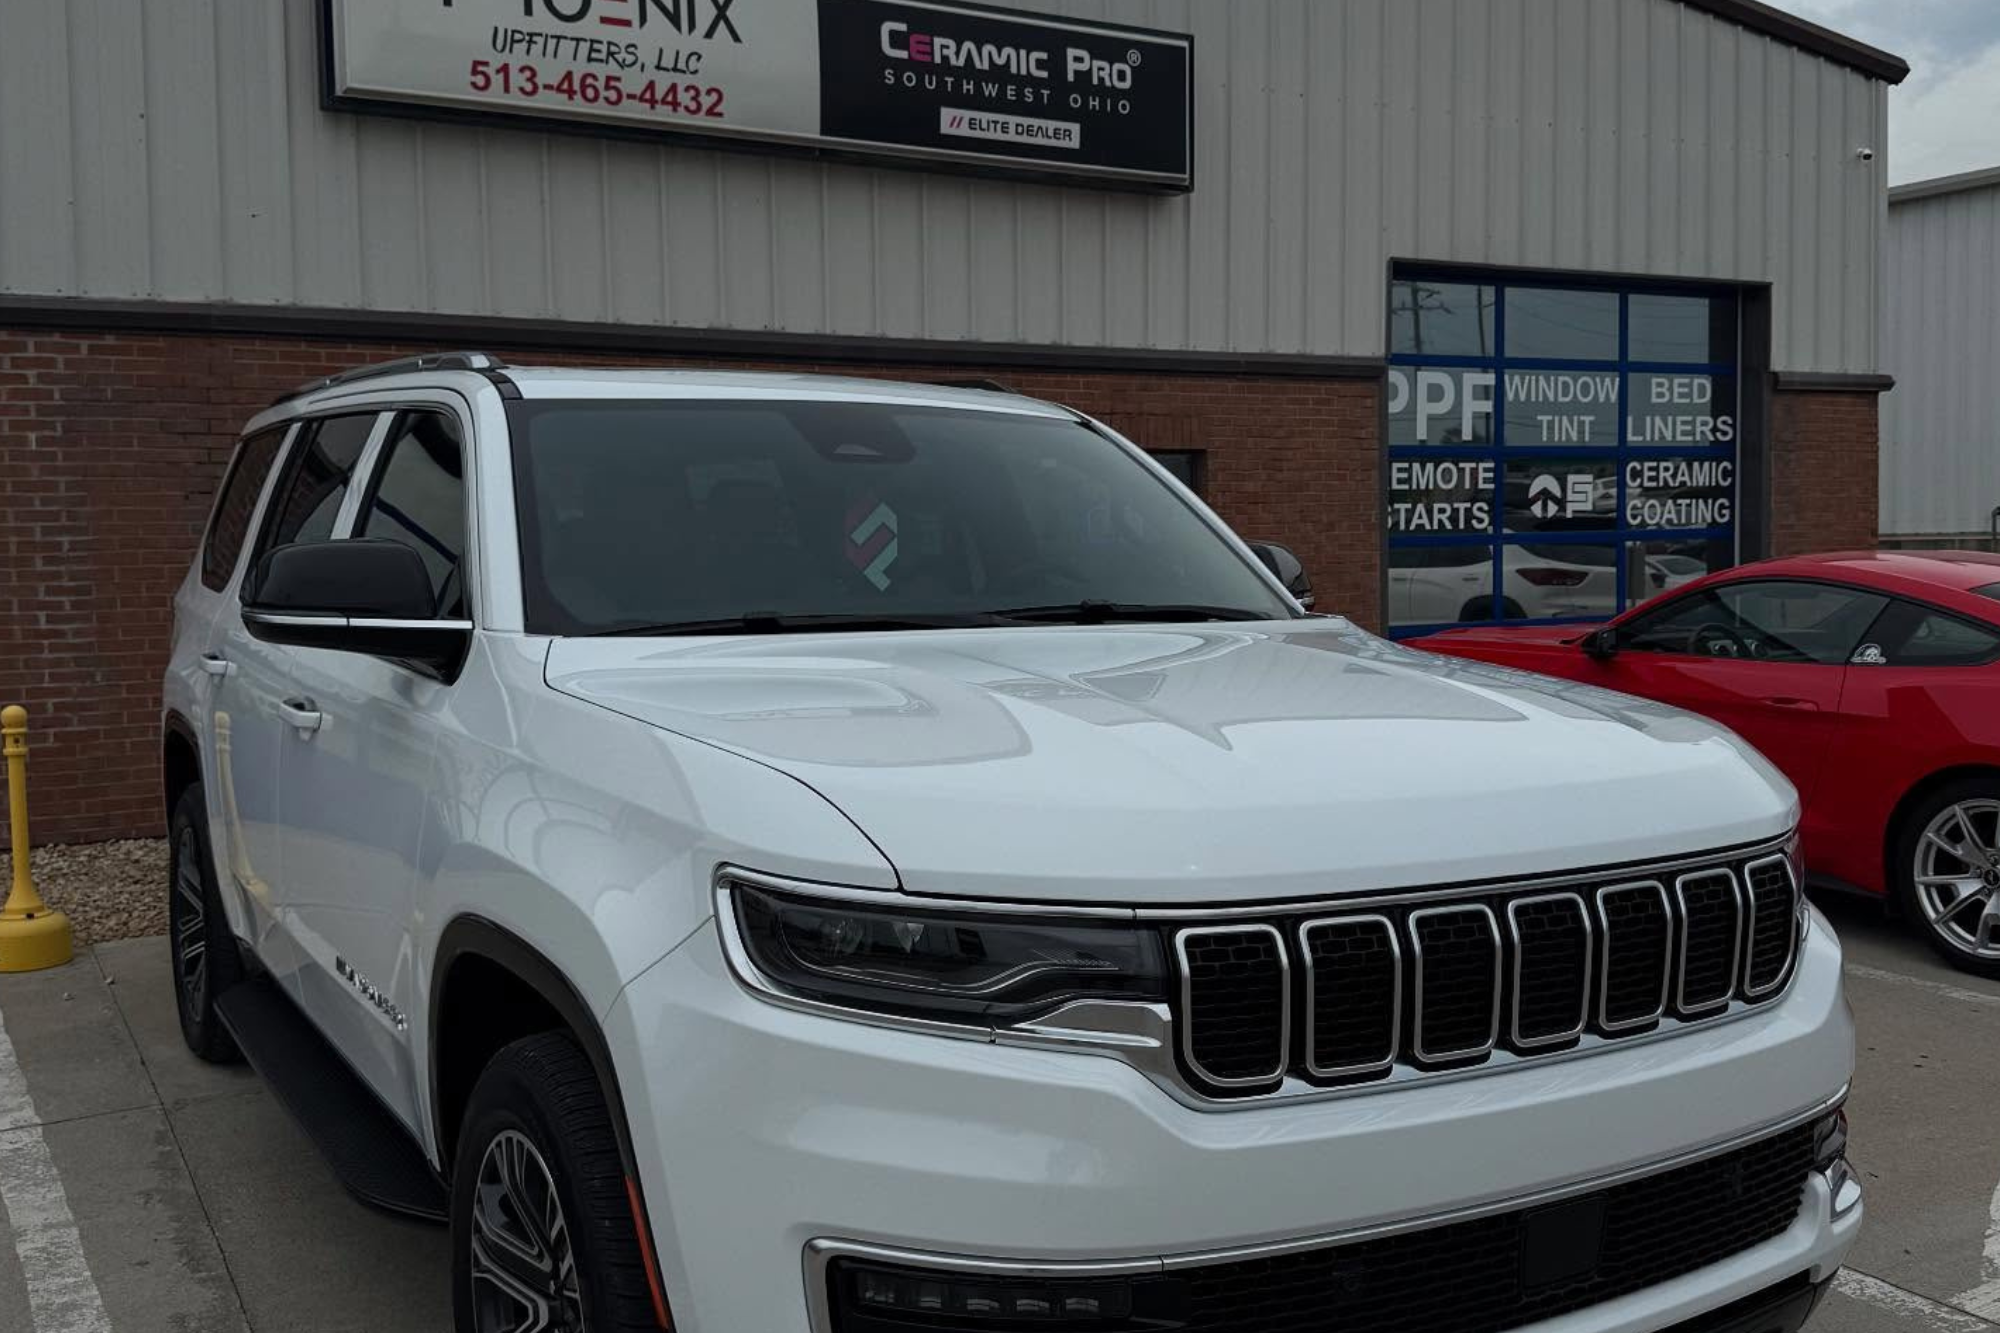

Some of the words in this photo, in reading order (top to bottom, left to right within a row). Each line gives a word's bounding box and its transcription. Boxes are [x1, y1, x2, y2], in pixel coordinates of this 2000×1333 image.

[654, 47, 702, 75] LLC
[880, 21, 1048, 78] CERAMIC
[470, 60, 725, 118] 513-465-4432
[884, 69, 1050, 104] SOUTHWEST
[1069, 94, 1131, 114] OHIO
[968, 117, 1010, 134] ELITE
[1015, 123, 1073, 142] DEALER
[1503, 374, 1620, 402] WINDOW
[1651, 378, 1712, 404] BED
[1536, 415, 1596, 442] TINT
[1626, 416, 1734, 442] LINERS
[1388, 462, 1495, 490] EMOTE
[1626, 461, 1733, 488] CERAMIC
[1388, 502, 1490, 531] TARTS
[1626, 498, 1731, 525] COATING
